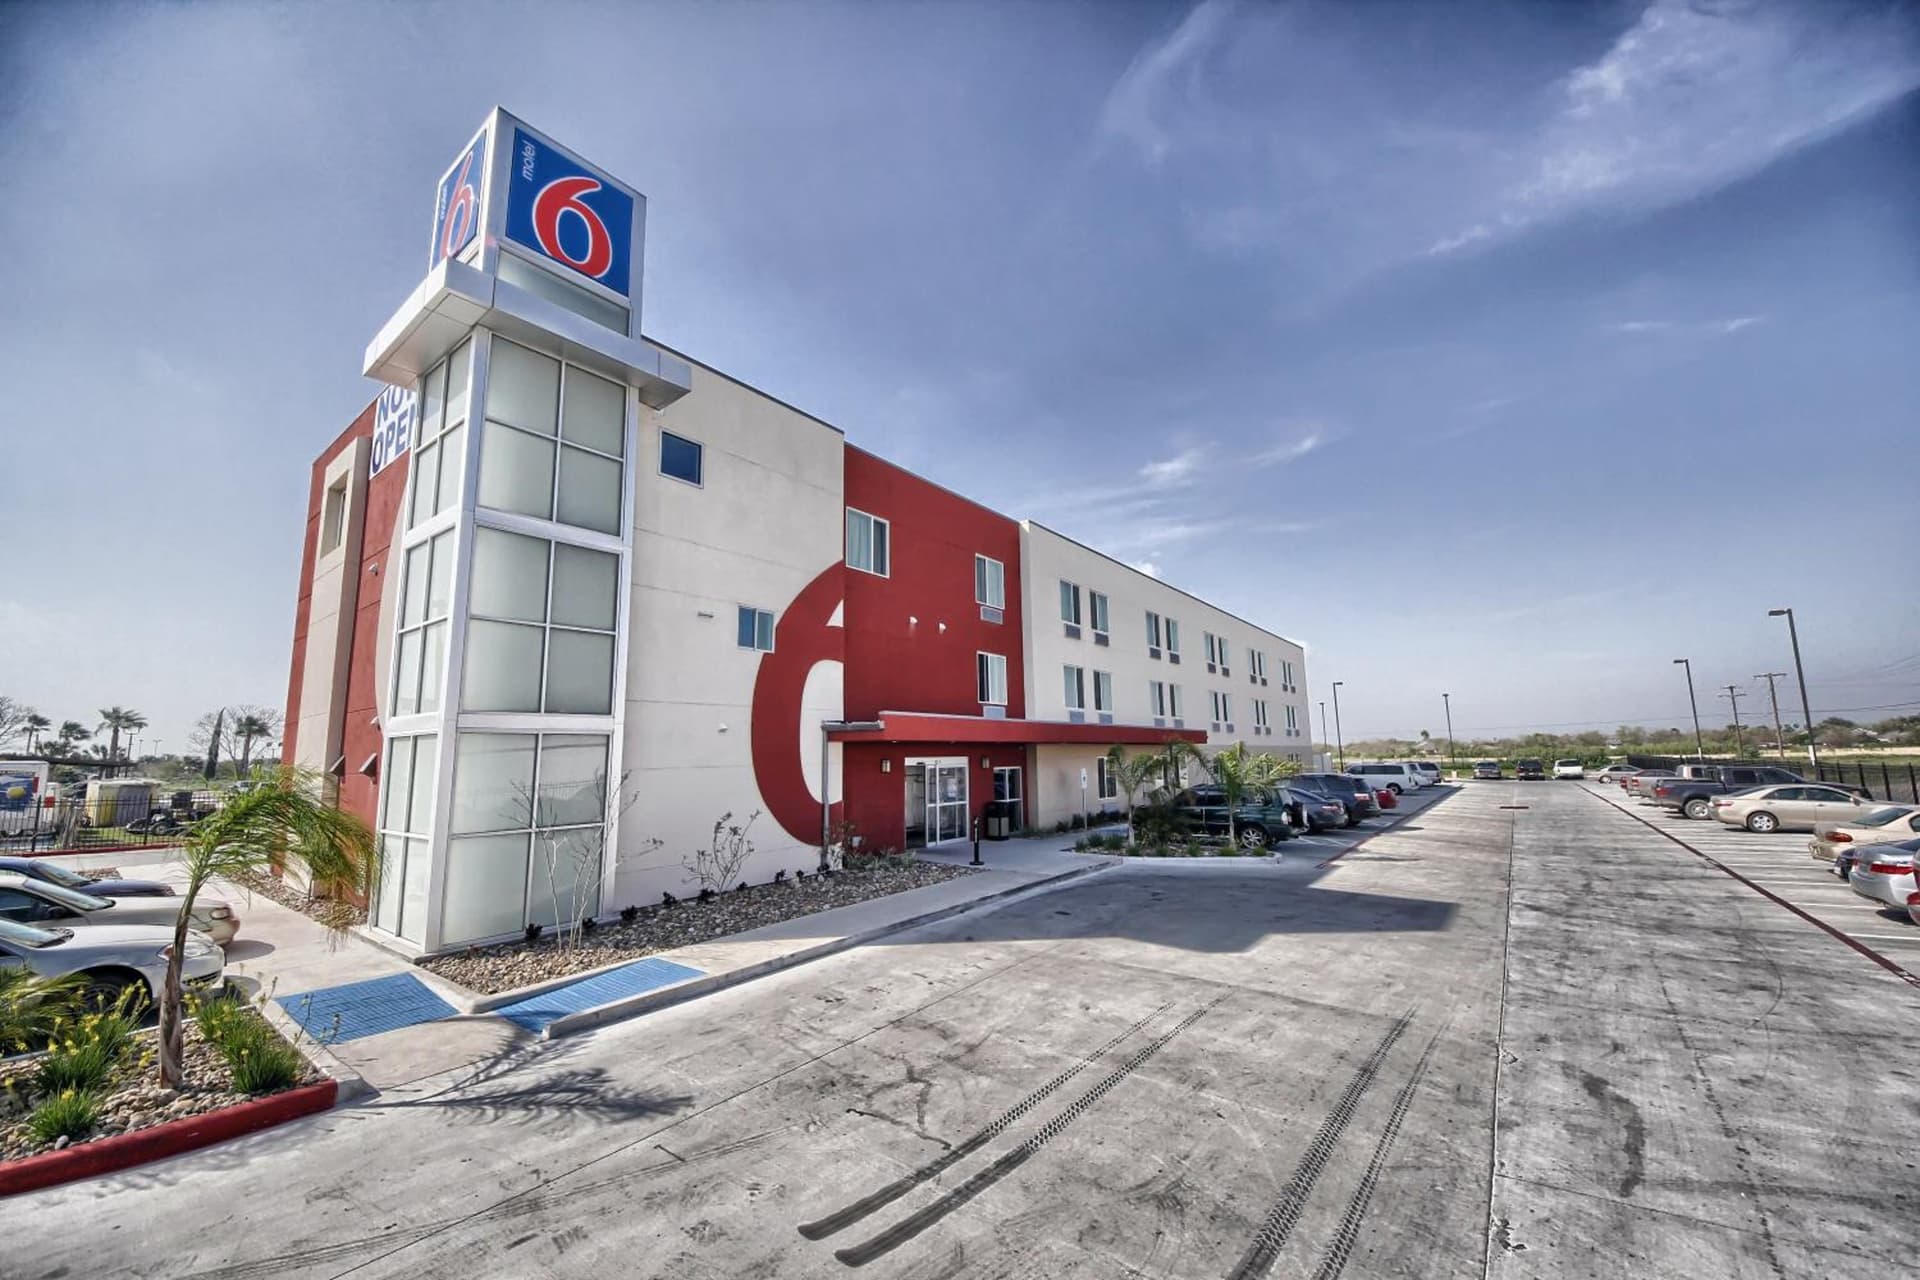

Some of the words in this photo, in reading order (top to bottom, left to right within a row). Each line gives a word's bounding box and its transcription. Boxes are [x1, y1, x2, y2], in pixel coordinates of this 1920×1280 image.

[521, 140, 536, 182] motel
[440, 151, 474, 262] 6
[532, 176, 613, 278] 6
[377, 385, 413, 428] NO
